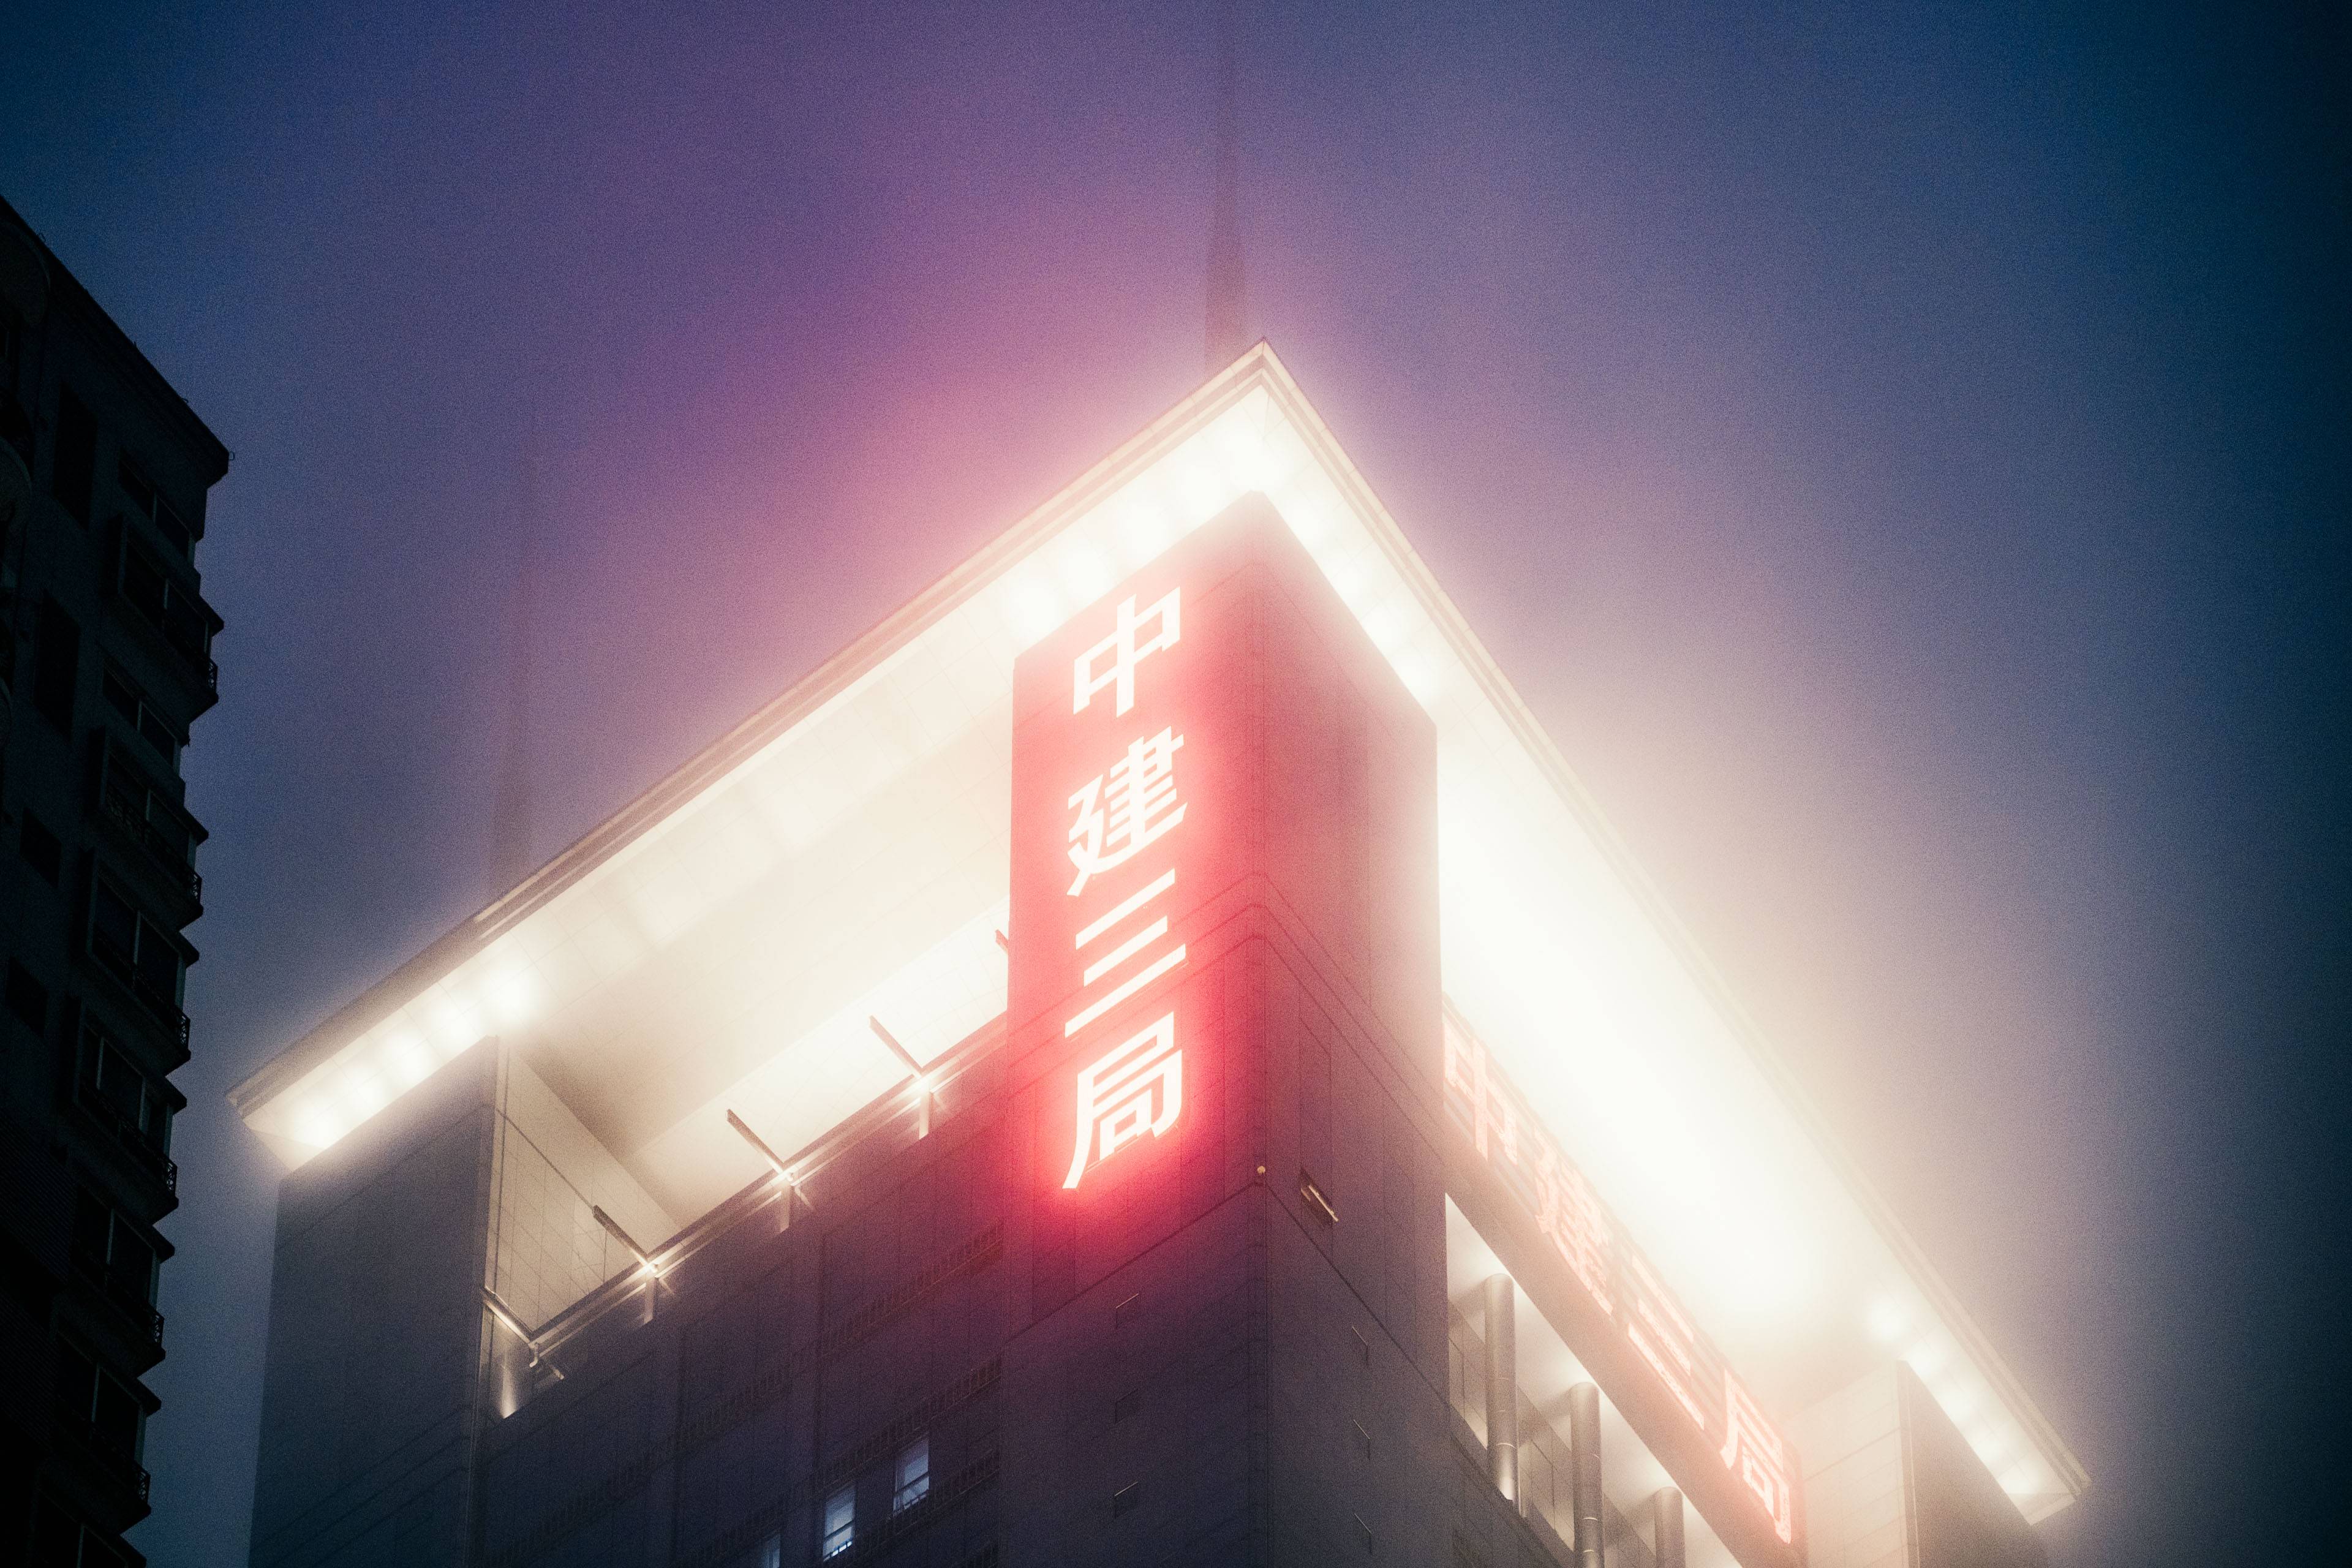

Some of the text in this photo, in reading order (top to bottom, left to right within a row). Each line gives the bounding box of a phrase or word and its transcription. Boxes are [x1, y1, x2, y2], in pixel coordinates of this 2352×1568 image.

[1062, 586, 1188, 1189] 中建三局
[1444, 1017, 1791, 1544] 中建三局
